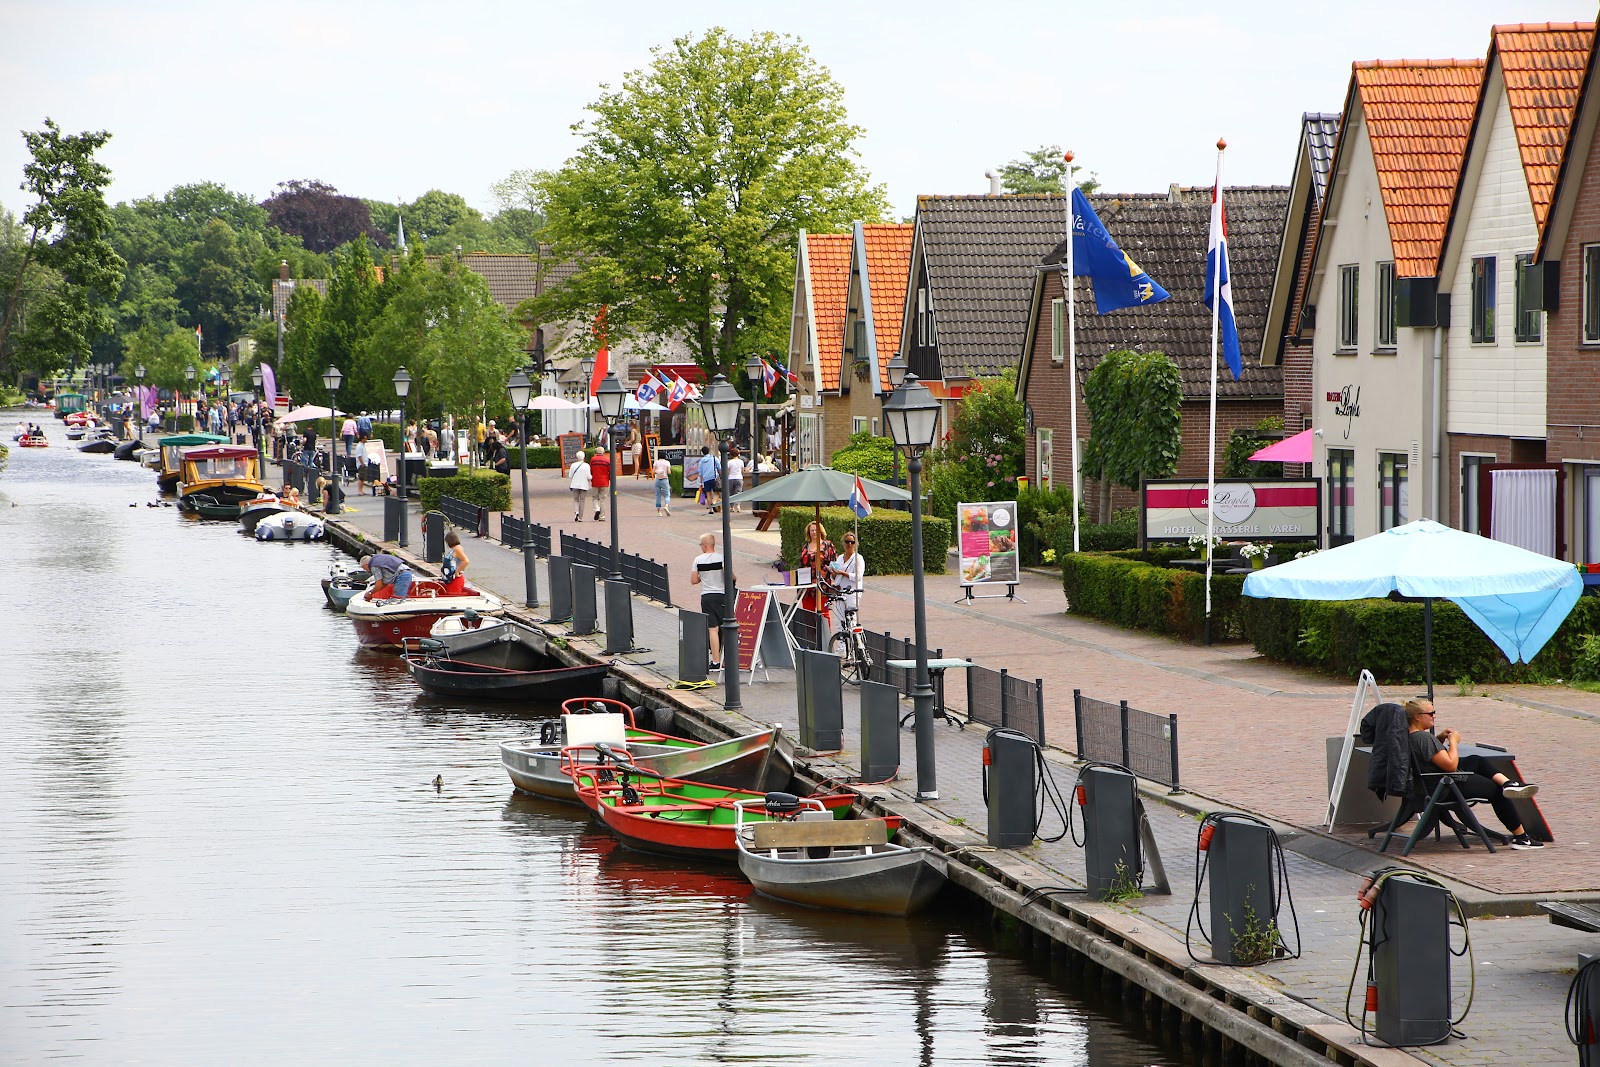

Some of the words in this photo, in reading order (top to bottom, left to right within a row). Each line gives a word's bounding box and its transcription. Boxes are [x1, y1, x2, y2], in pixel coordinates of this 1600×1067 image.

[1213, 490, 1250, 513] Pergola
[1164, 526, 1197, 535] HOTEL
[1206, 525, 1260, 535] RASSERIE
[1268, 524, 1302, 534] VAREN
